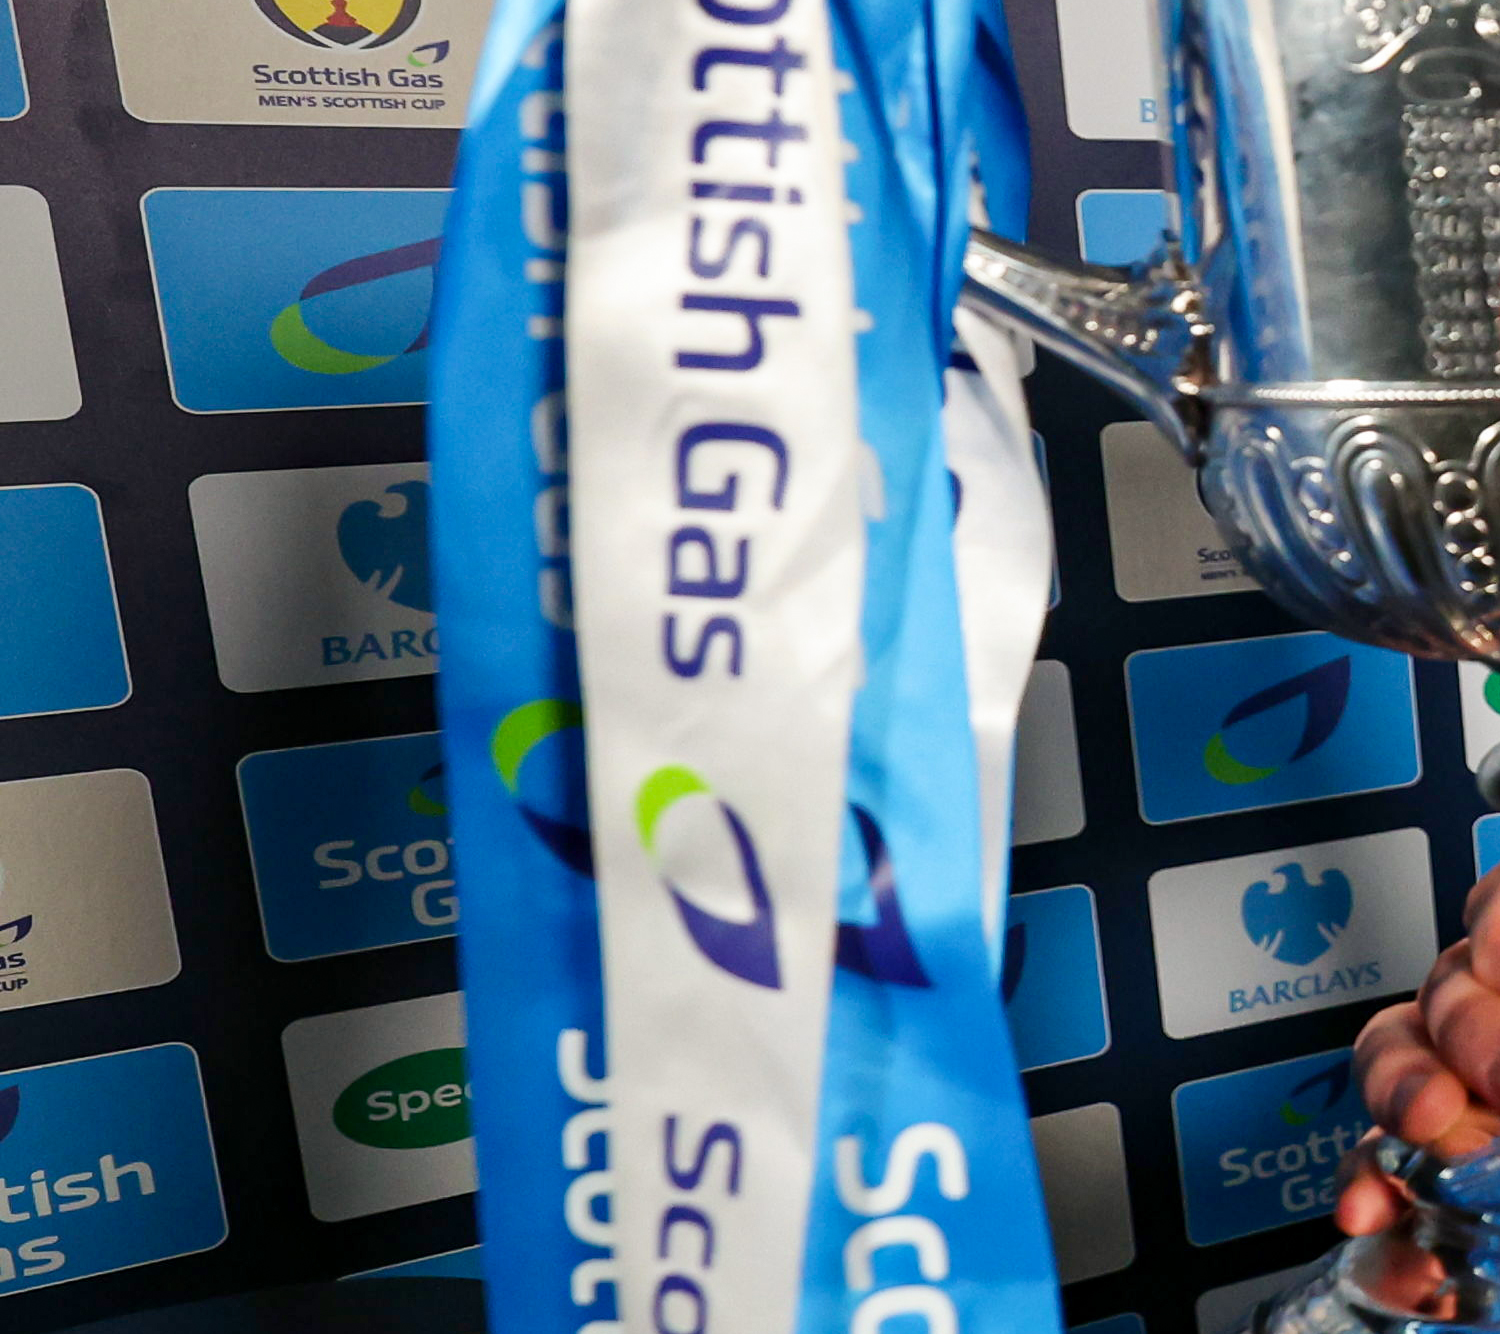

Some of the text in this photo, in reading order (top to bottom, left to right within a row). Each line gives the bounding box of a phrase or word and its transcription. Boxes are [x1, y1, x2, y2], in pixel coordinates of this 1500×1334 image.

[253, 63, 444, 89] Scottish Gas
[258, 95, 446, 113] MEN'S SCOTTISH CUP
[661, 420, 792, 680] Gas
[1229, 962, 1382, 1013] BARCLAYS
[0, 1154, 156, 1223] tish
